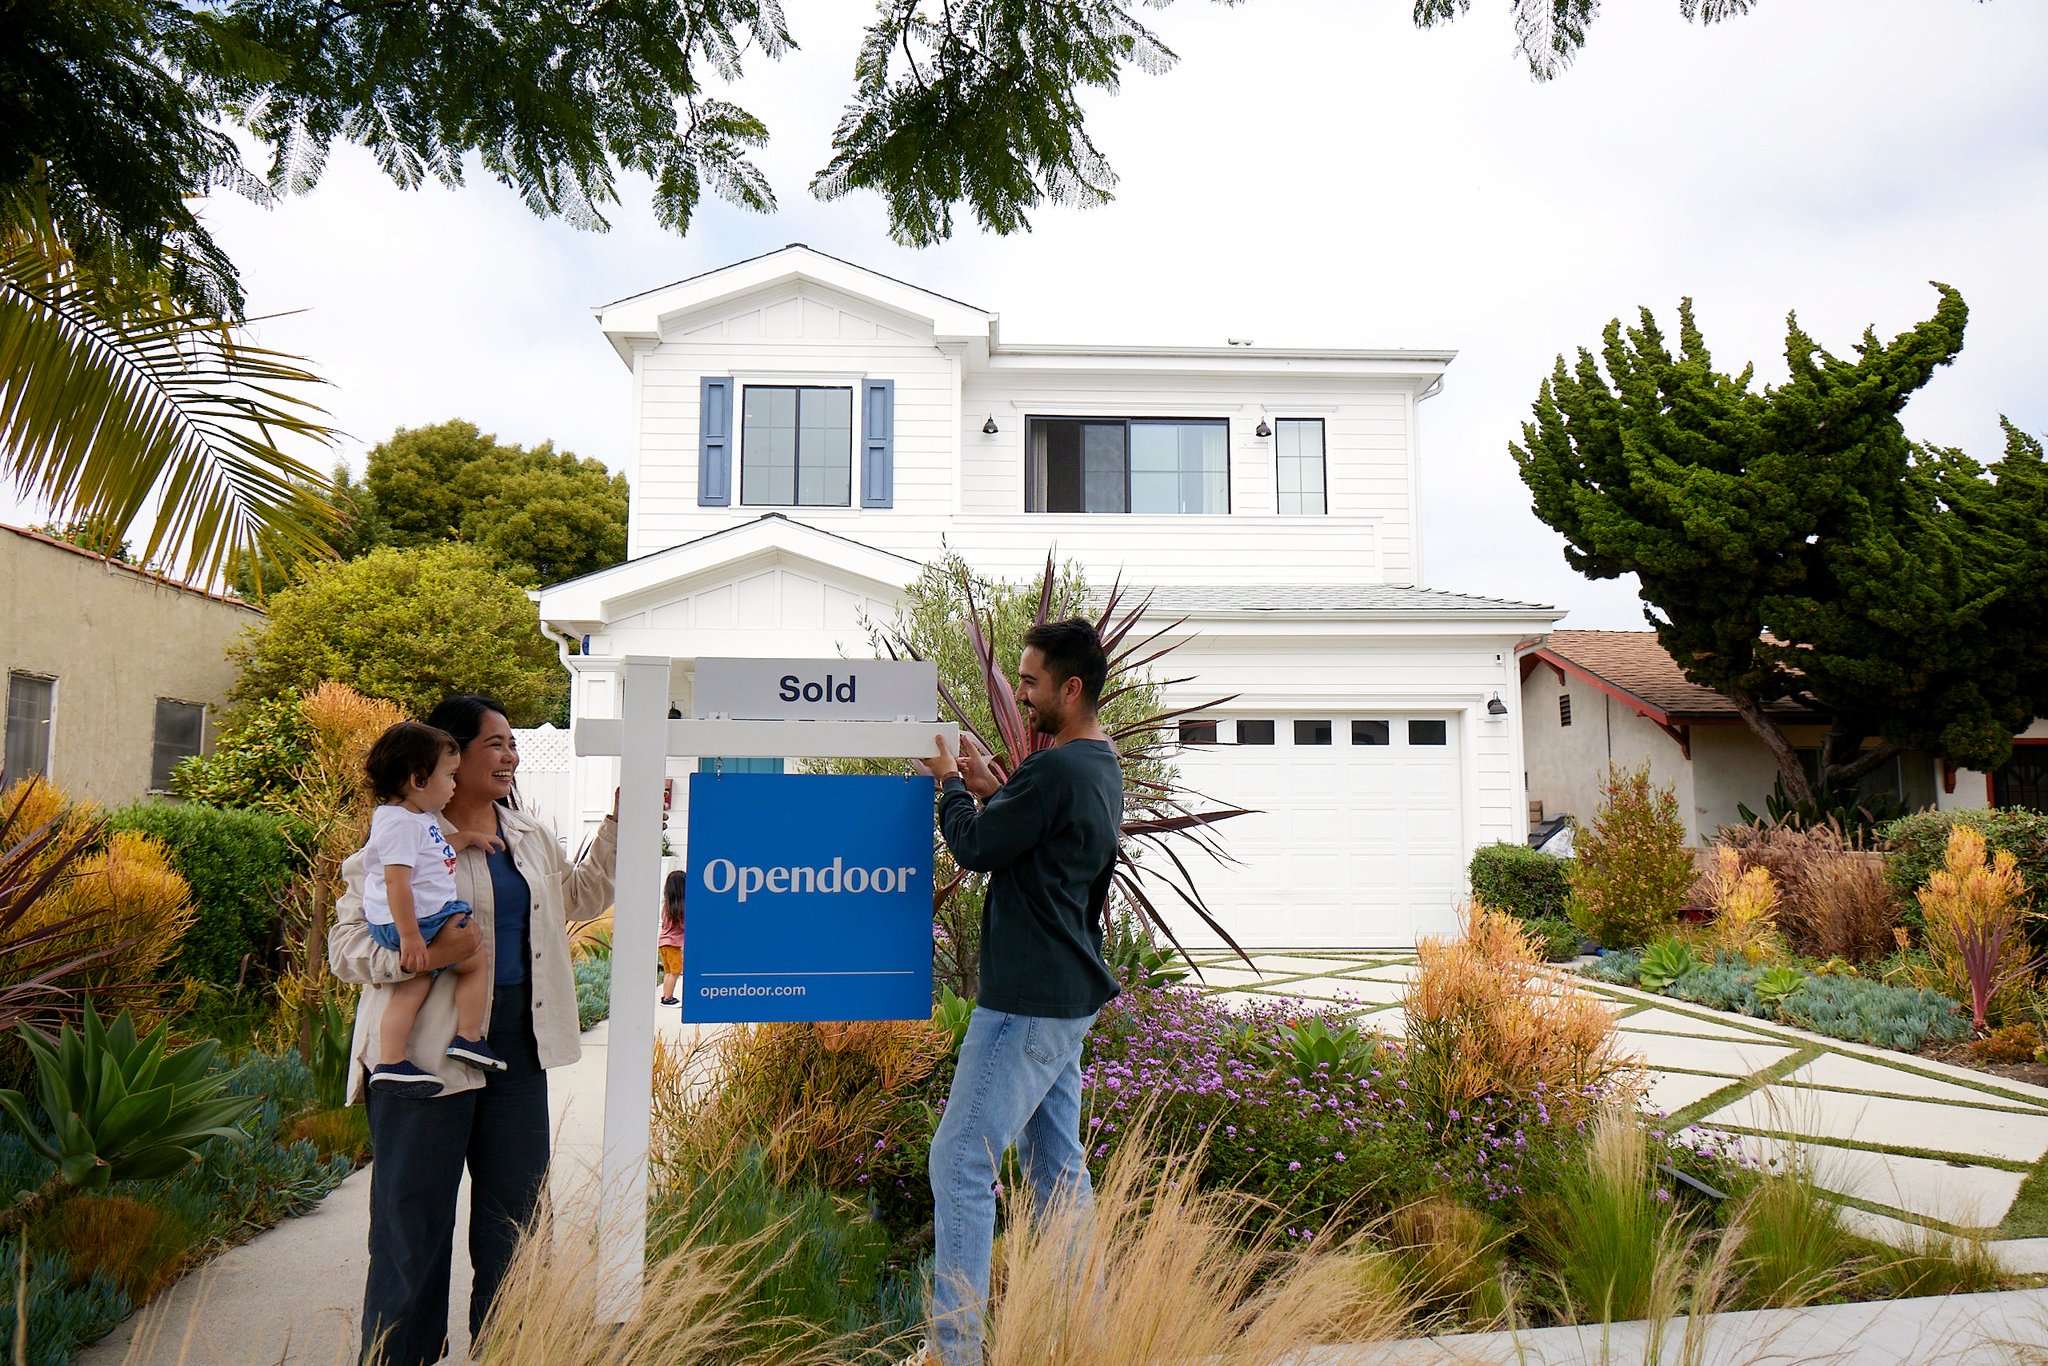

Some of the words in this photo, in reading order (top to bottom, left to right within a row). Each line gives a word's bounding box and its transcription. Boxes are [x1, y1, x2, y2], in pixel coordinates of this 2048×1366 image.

[778, 674, 856, 703] Sold
[703, 856, 917, 903] Opendoor
[700, 983, 806, 1000] opendoor.com
